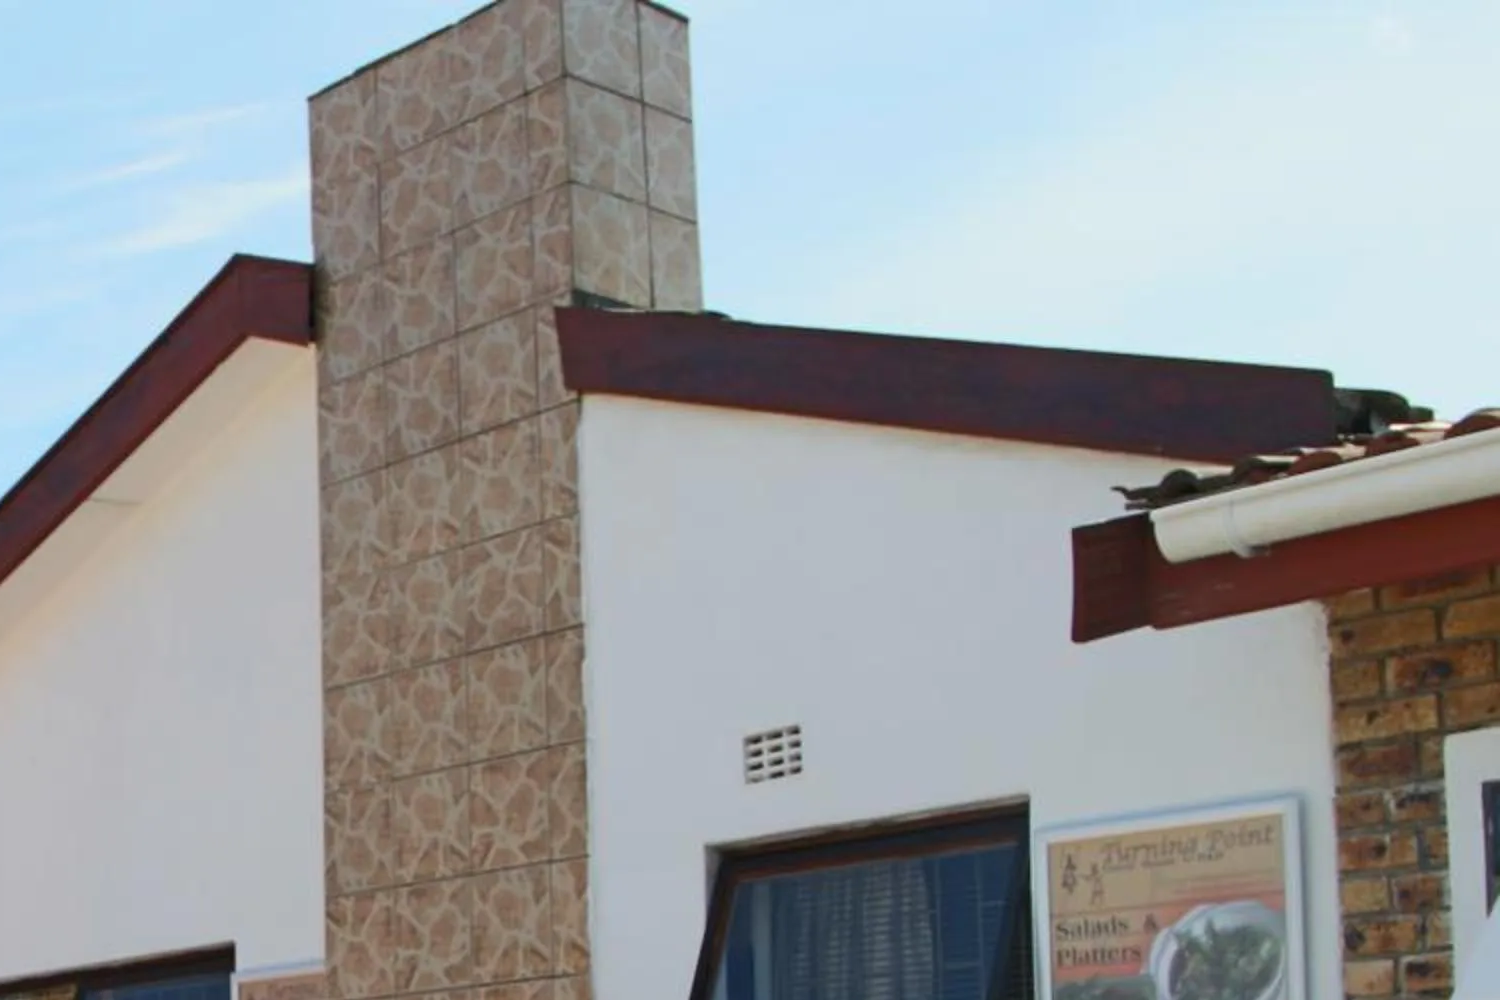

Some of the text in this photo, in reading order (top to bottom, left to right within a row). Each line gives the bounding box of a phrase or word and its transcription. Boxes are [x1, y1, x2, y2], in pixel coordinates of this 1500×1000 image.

[1206, 823, 1273, 853] Point
[1056, 915, 1129, 940] Salads
[1057, 945, 1141, 967] Platters
